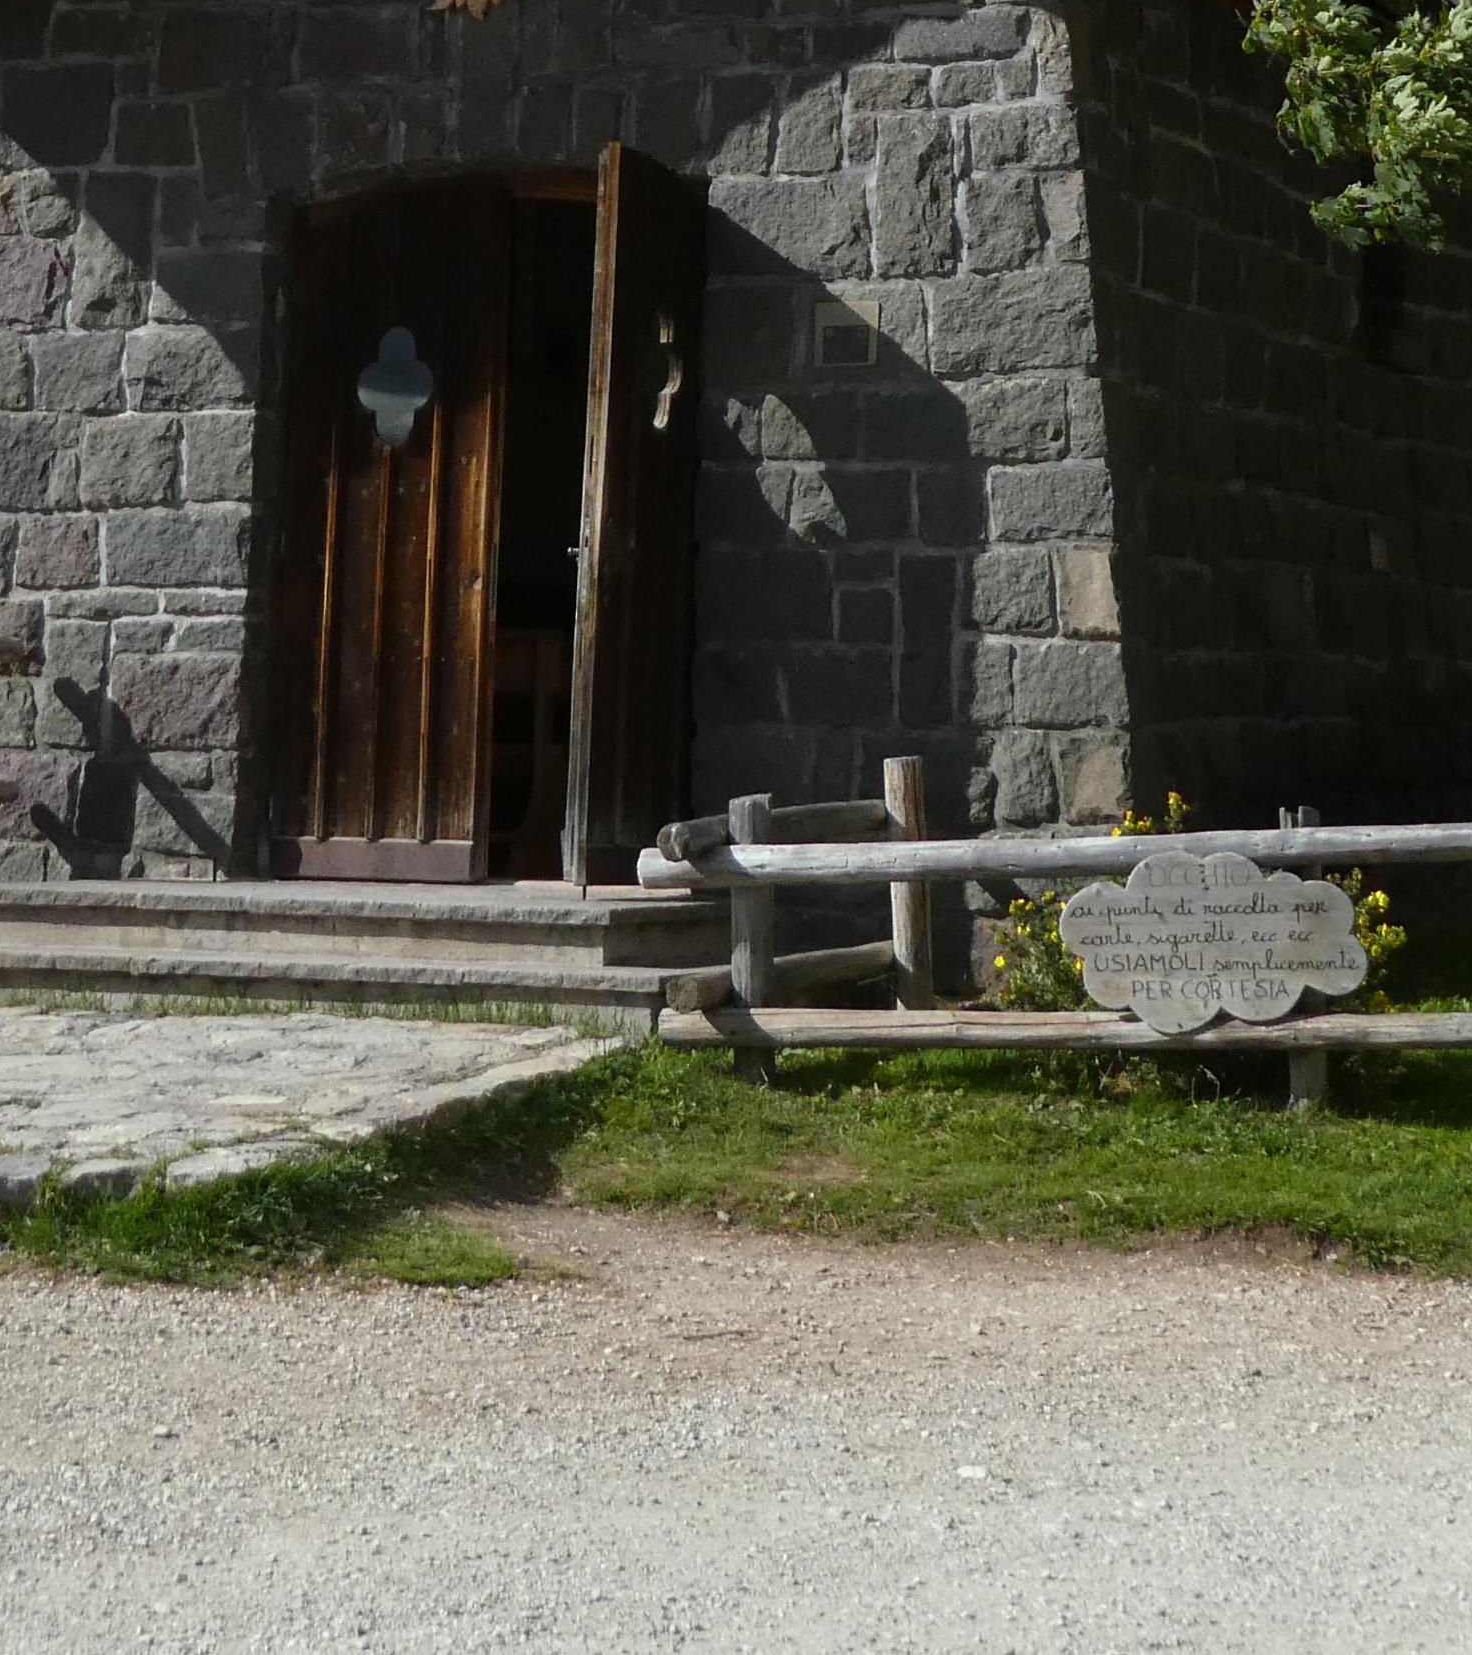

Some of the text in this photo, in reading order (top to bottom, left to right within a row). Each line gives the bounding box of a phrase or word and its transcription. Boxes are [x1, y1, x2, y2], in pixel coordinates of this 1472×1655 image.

[1173, 897, 1194, 915] di
[1203, 892, 1280, 915] raccolta
[1292, 901, 1329, 923] per
[1251, 931, 1278, 942] ecc
[1288, 930, 1314, 942] ecc
[1094, 948, 1359, 979] USIAMOLI semplicemente
[1132, 979, 1289, 1001] PER CORTESIA
